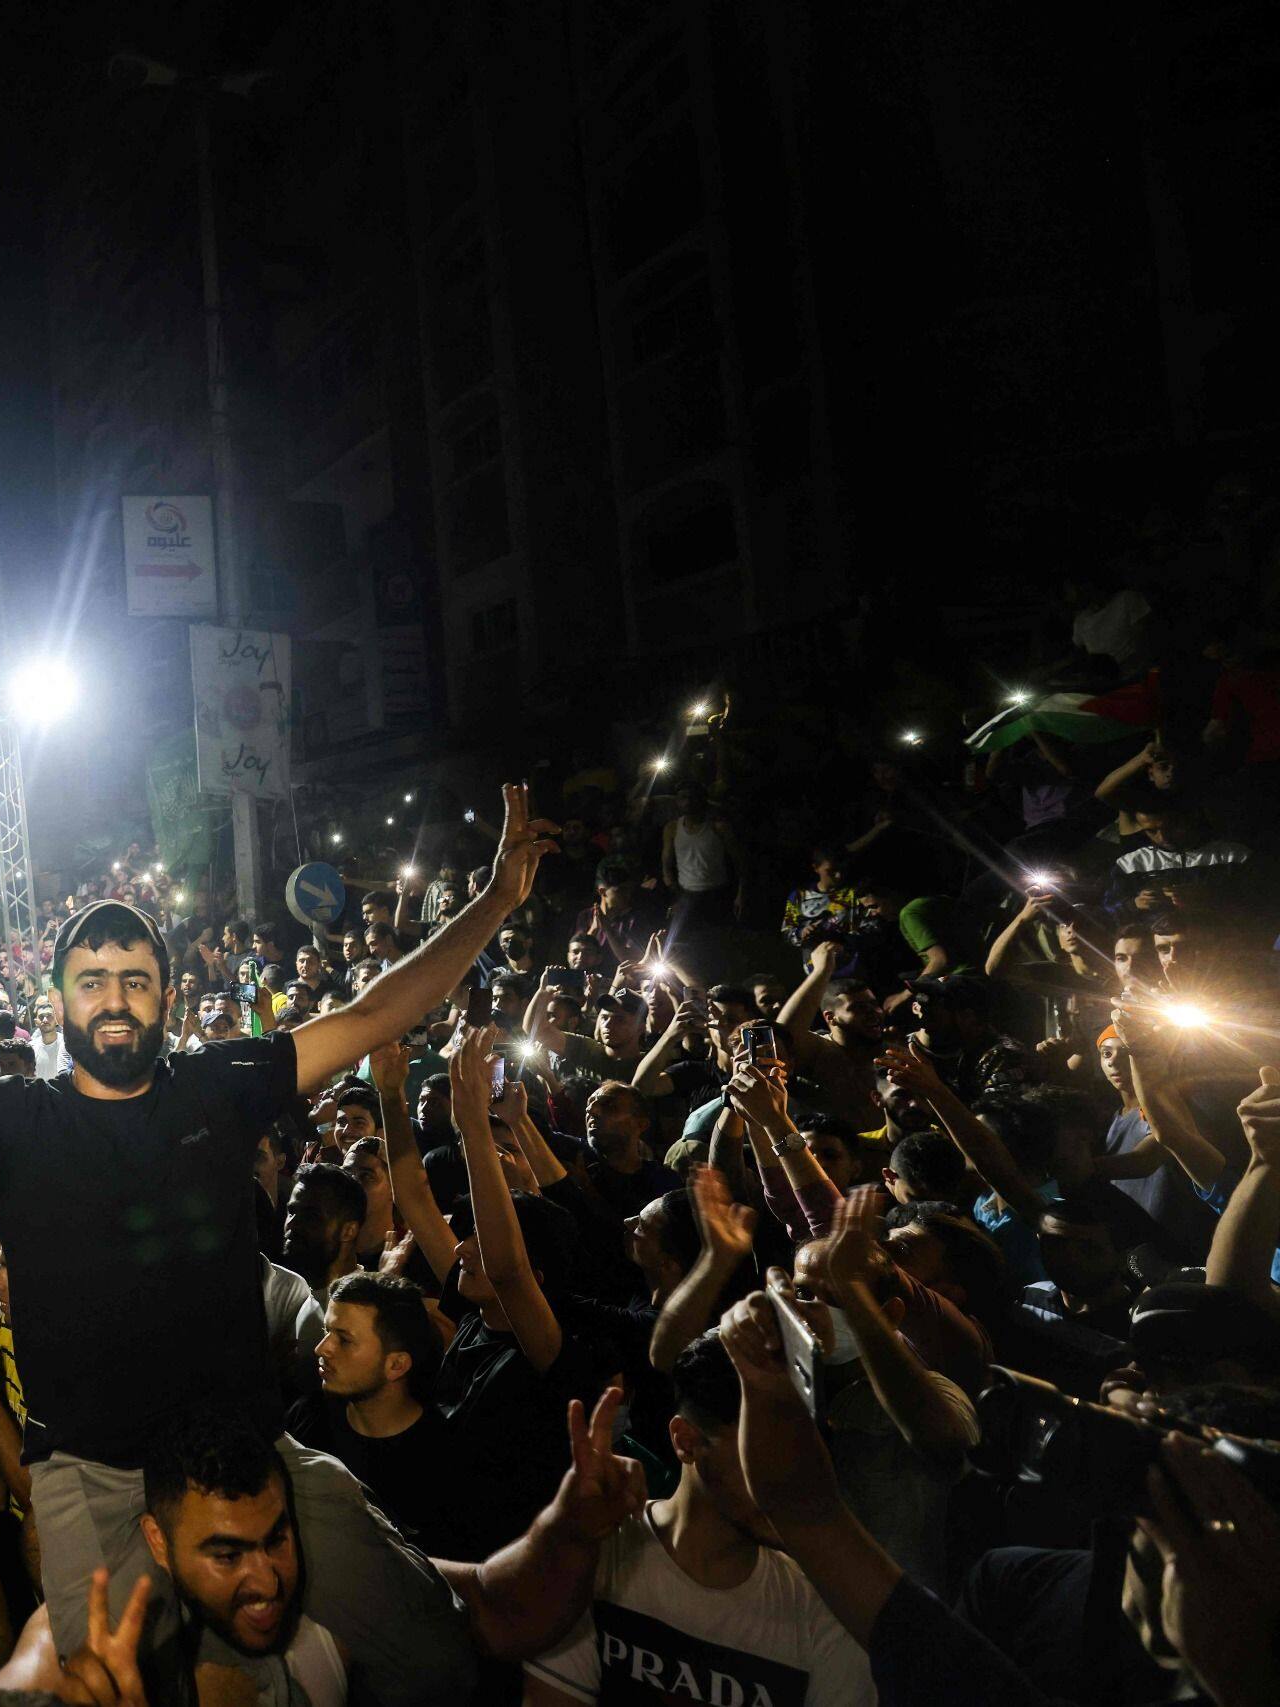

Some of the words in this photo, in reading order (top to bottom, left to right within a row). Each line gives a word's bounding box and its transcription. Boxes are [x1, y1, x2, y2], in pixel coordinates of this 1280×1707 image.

[222, 632, 270, 675] Joy
[222, 743, 271, 785] Joy
[601, 1630, 774, 1707] PRADA
